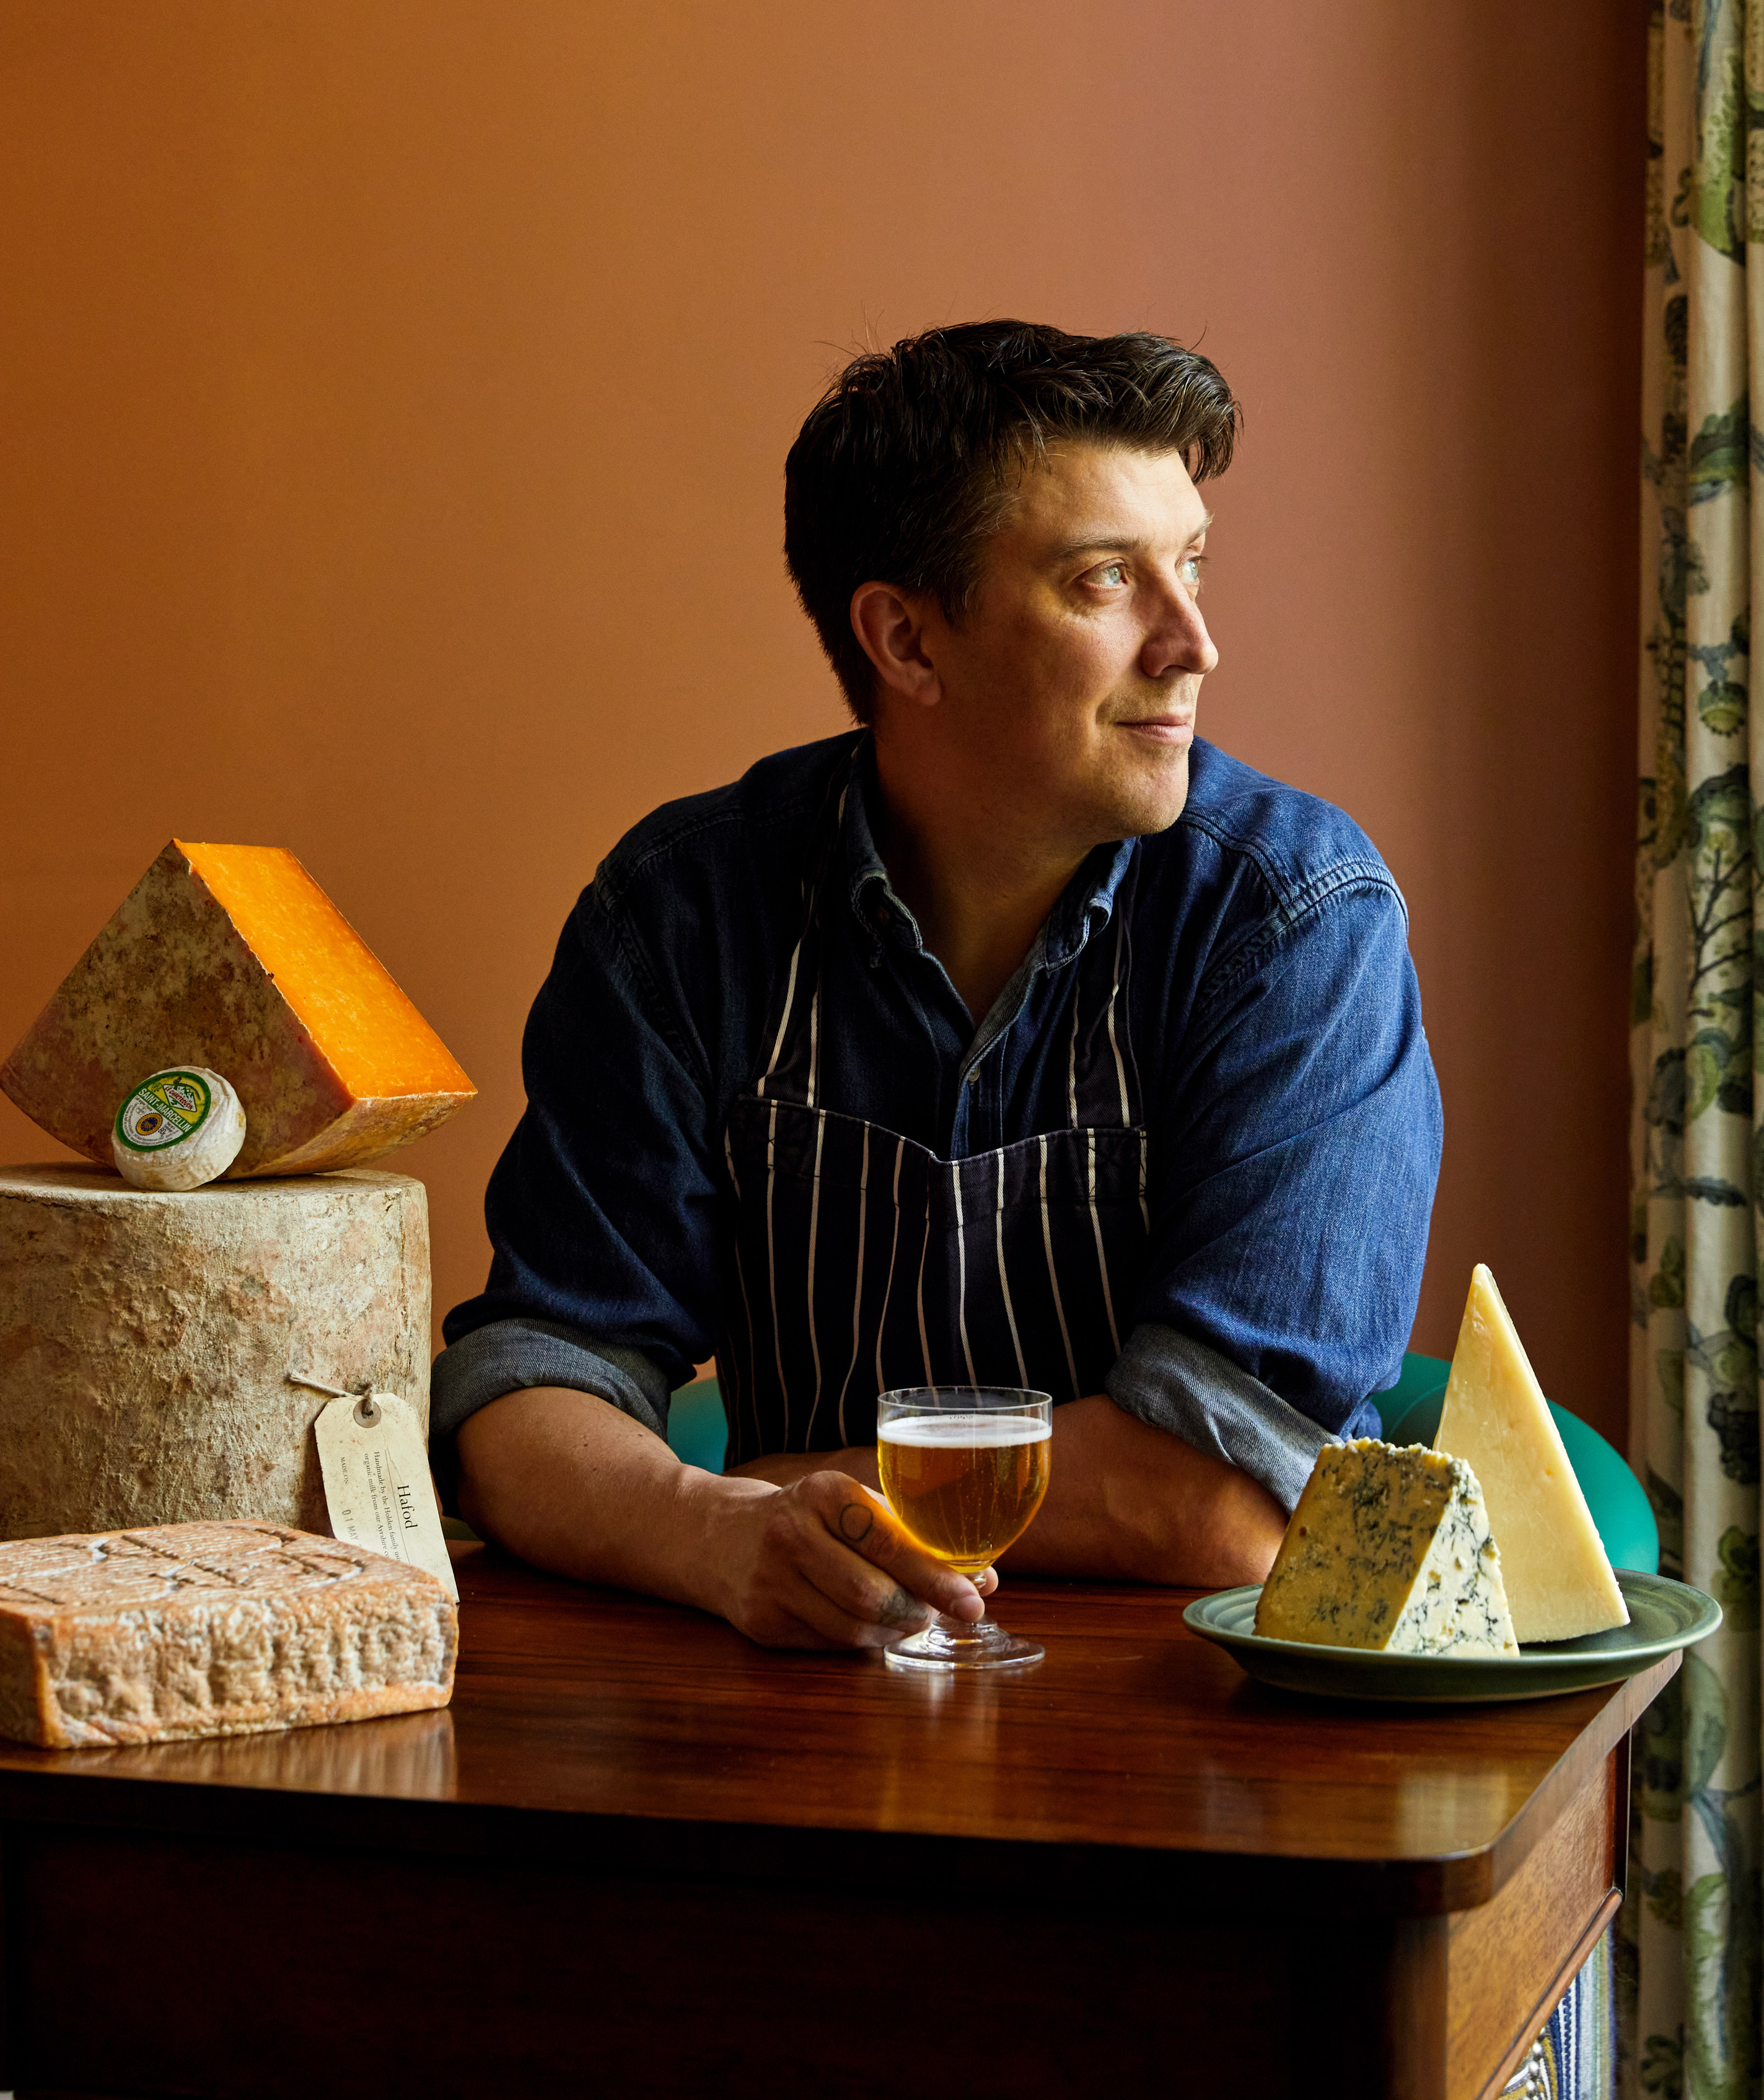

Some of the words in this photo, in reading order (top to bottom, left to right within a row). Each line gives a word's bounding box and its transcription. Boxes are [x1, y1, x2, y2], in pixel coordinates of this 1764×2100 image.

[139, 1088, 192, 1132] SAINT-MARCELLIN
[374, 1451, 385, 1485] Handmade
[363, 1453, 372, 1477] organic
[368, 1478, 376, 1493] milk
[377, 1524, 387, 1549] Ayrshire
[378, 1486, 385, 1494] by
[384, 1507, 393, 1531] Holden
[398, 1485, 418, 1529] Hafod
[347, 1526, 359, 1539] MAY
[389, 1531, 398, 1549] family
